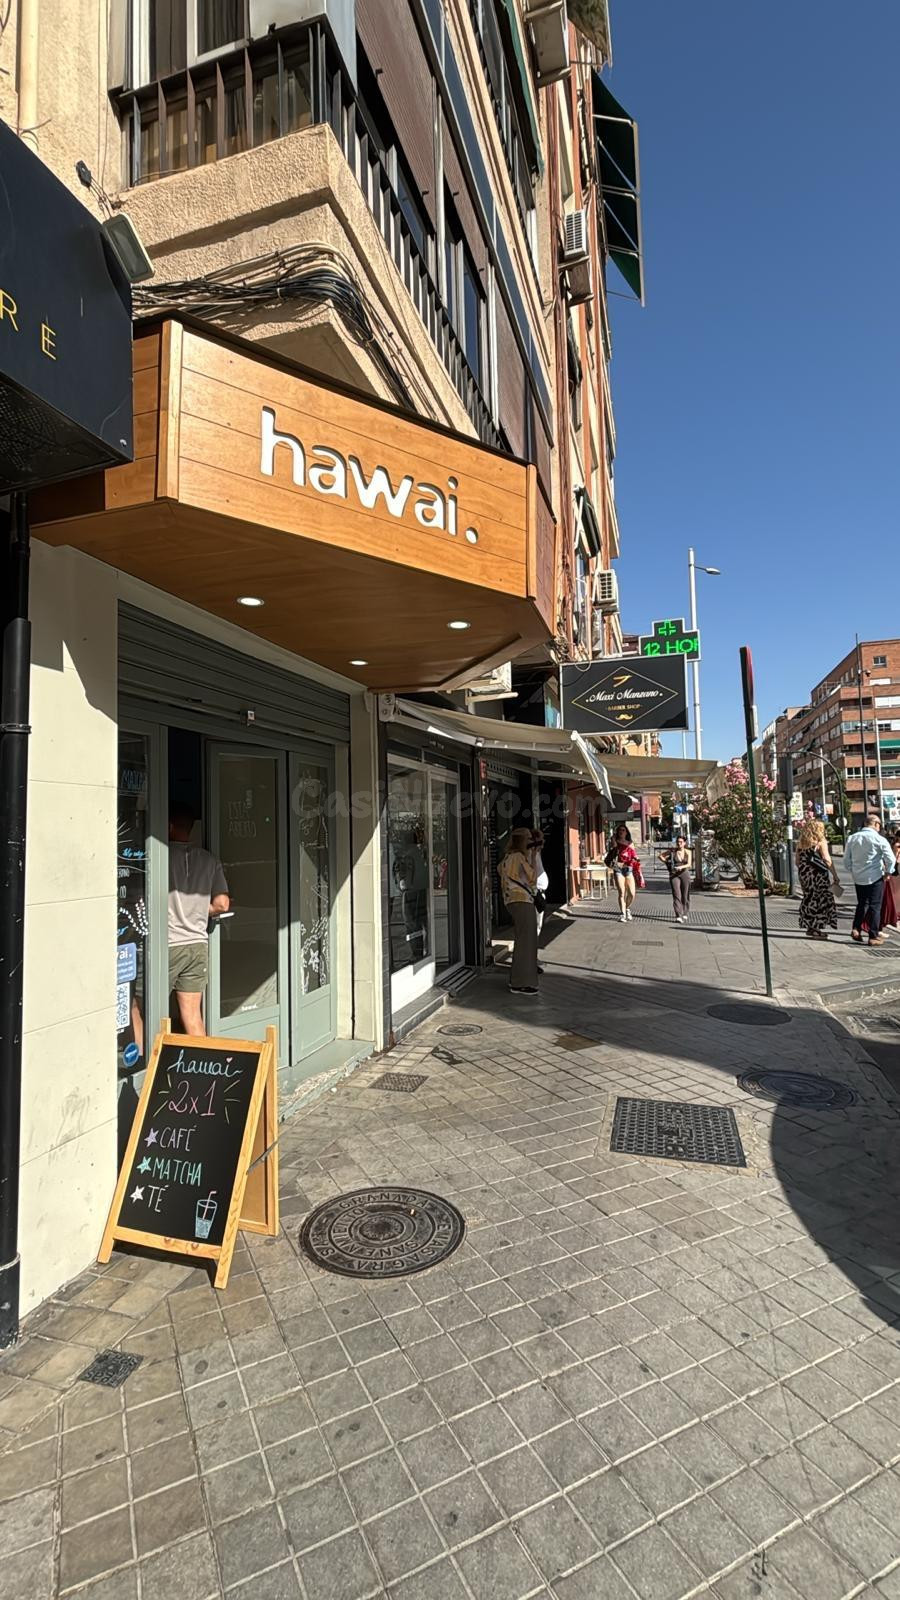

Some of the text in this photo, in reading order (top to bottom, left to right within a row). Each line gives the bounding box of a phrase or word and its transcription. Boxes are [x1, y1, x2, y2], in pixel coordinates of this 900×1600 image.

[260, 405, 479, 544] hawai.
[643, 638, 699, 656] 12 HO
[616, 688, 659, 700] Manzano
[167, 1050, 243, 1077] hawai
[168, 1080, 217, 1117] 2x1
[159, 1126, 197, 1152] CAFÉ
[152, 1158, 203, 1187] MATCHA
[147, 1184, 169, 1213] TÉ
[338, 1191, 431, 1209] GRANADA
